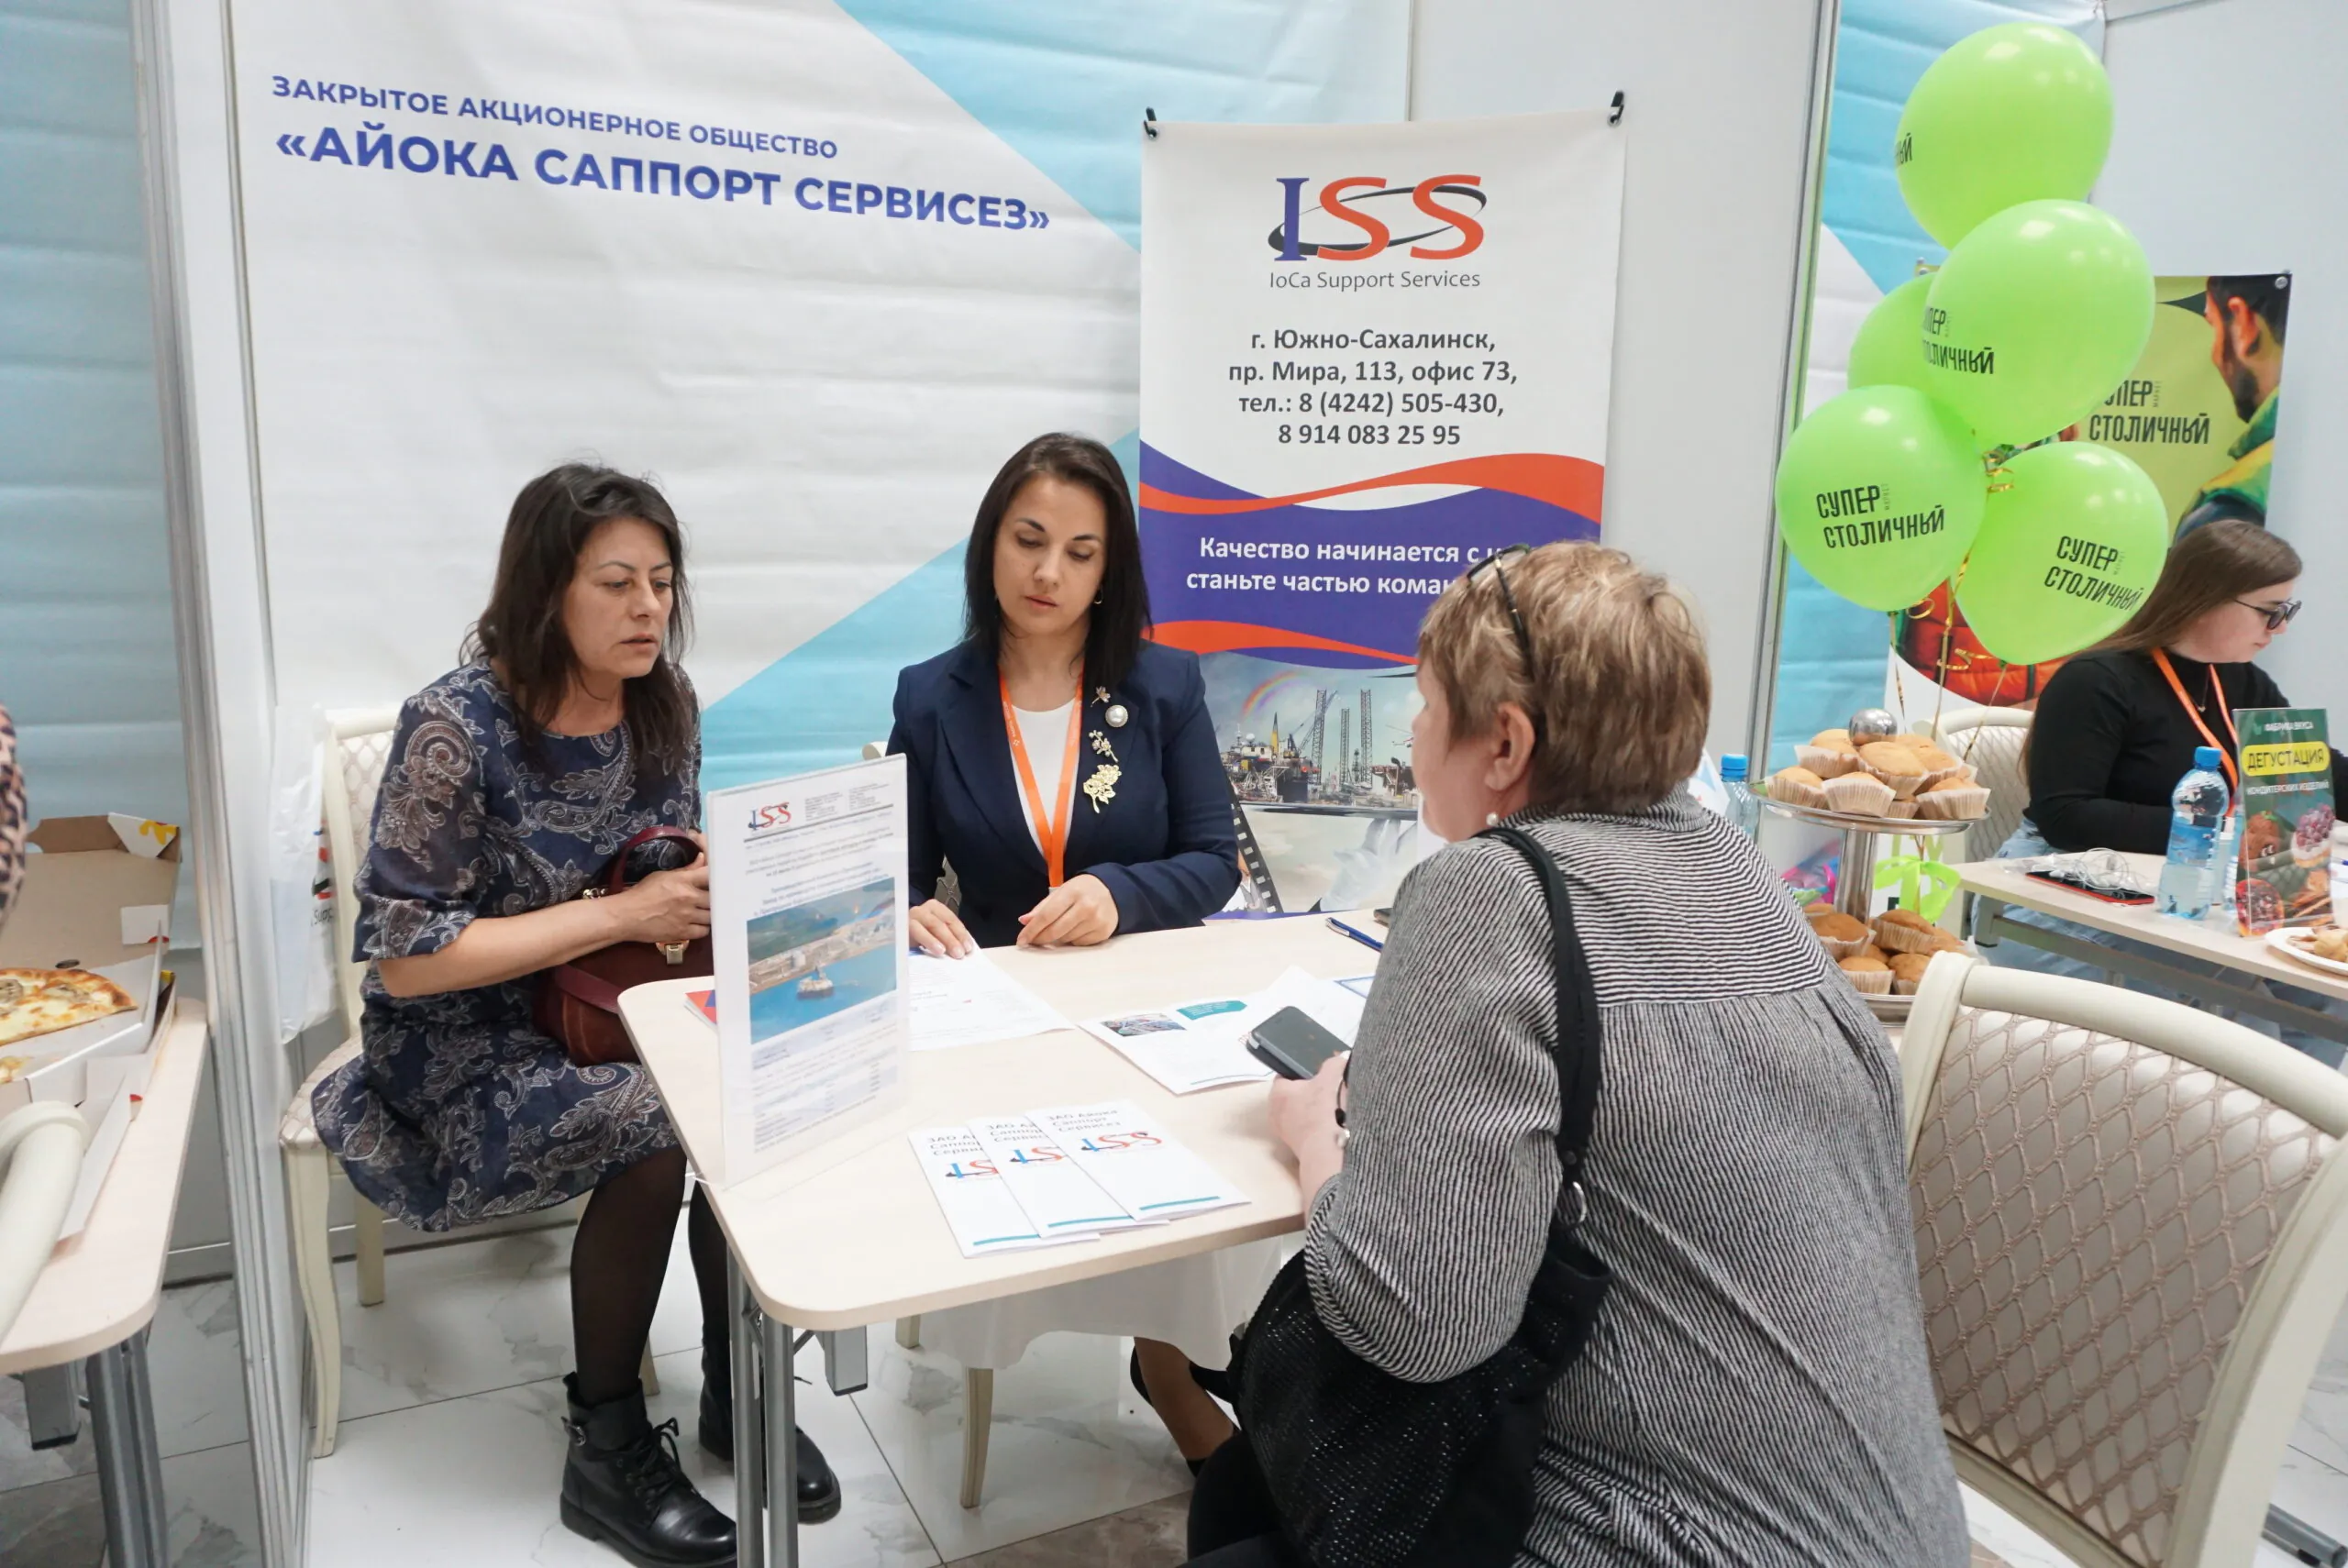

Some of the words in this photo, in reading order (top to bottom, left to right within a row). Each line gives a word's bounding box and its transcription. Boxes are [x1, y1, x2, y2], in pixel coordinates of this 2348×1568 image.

[272, 75, 449, 116] ЗАКРЫТОЕ
[458, 96, 681, 143] АКЦИОНЕРНОЕ
[689, 124, 838, 160] ОБЩЕСТВО
[276, 120, 519, 182] «АЙОКА
[535, 149, 781, 207] САППОРТ
[794, 176, 1051, 233] СЕРВИСЕЗ»
[1274, 173, 1485, 261] ISS
[1269, 271, 1311, 289] IoCa
[1317, 271, 1395, 293] Support
[1401, 271, 1481, 288] Services
[1251, 334, 1266, 350] г.
[1274, 328, 1497, 352] Южно-Сахалинск,
[1229, 366, 1264, 386] пр.
[1272, 361, 1347, 386] Мира,
[1356, 361, 1405, 385] 113,
[1411, 359, 1475, 386] офис
[1482, 360, 1518, 385] 73,
[1238, 396, 1291, 414] тел.:
[1298, 393, 1312, 414] 8
[1320, 392, 1394, 418] (4242)
[1401, 392, 1504, 417] 505-430,
[1278, 425, 1291, 445] 8
[1299, 425, 1341, 445] 914
[1347, 425, 1390, 445] 083
[1398, 425, 1426, 445] 25
[1433, 425, 1460, 445] 95
[2089, 412, 2210, 445] СТОЛИЧНЫЙ
[1815, 484, 1881, 519] СУПЕР
[1822, 503, 1945, 549] СТОЛИЧНЫЙ
[1200, 536, 1310, 559] Качество
[1316, 542, 1460, 563] начинается
[1467, 547, 1479, 563] с
[2055, 536, 2119, 572] СУПЕР
[1186, 571, 1277, 591] станьте
[1283, 574, 1370, 593] частью
[2043, 566, 2145, 612] СТОЛИЧНЫЙ
[2247, 747, 2325, 772] ДЕГУСТАЦИЯ
